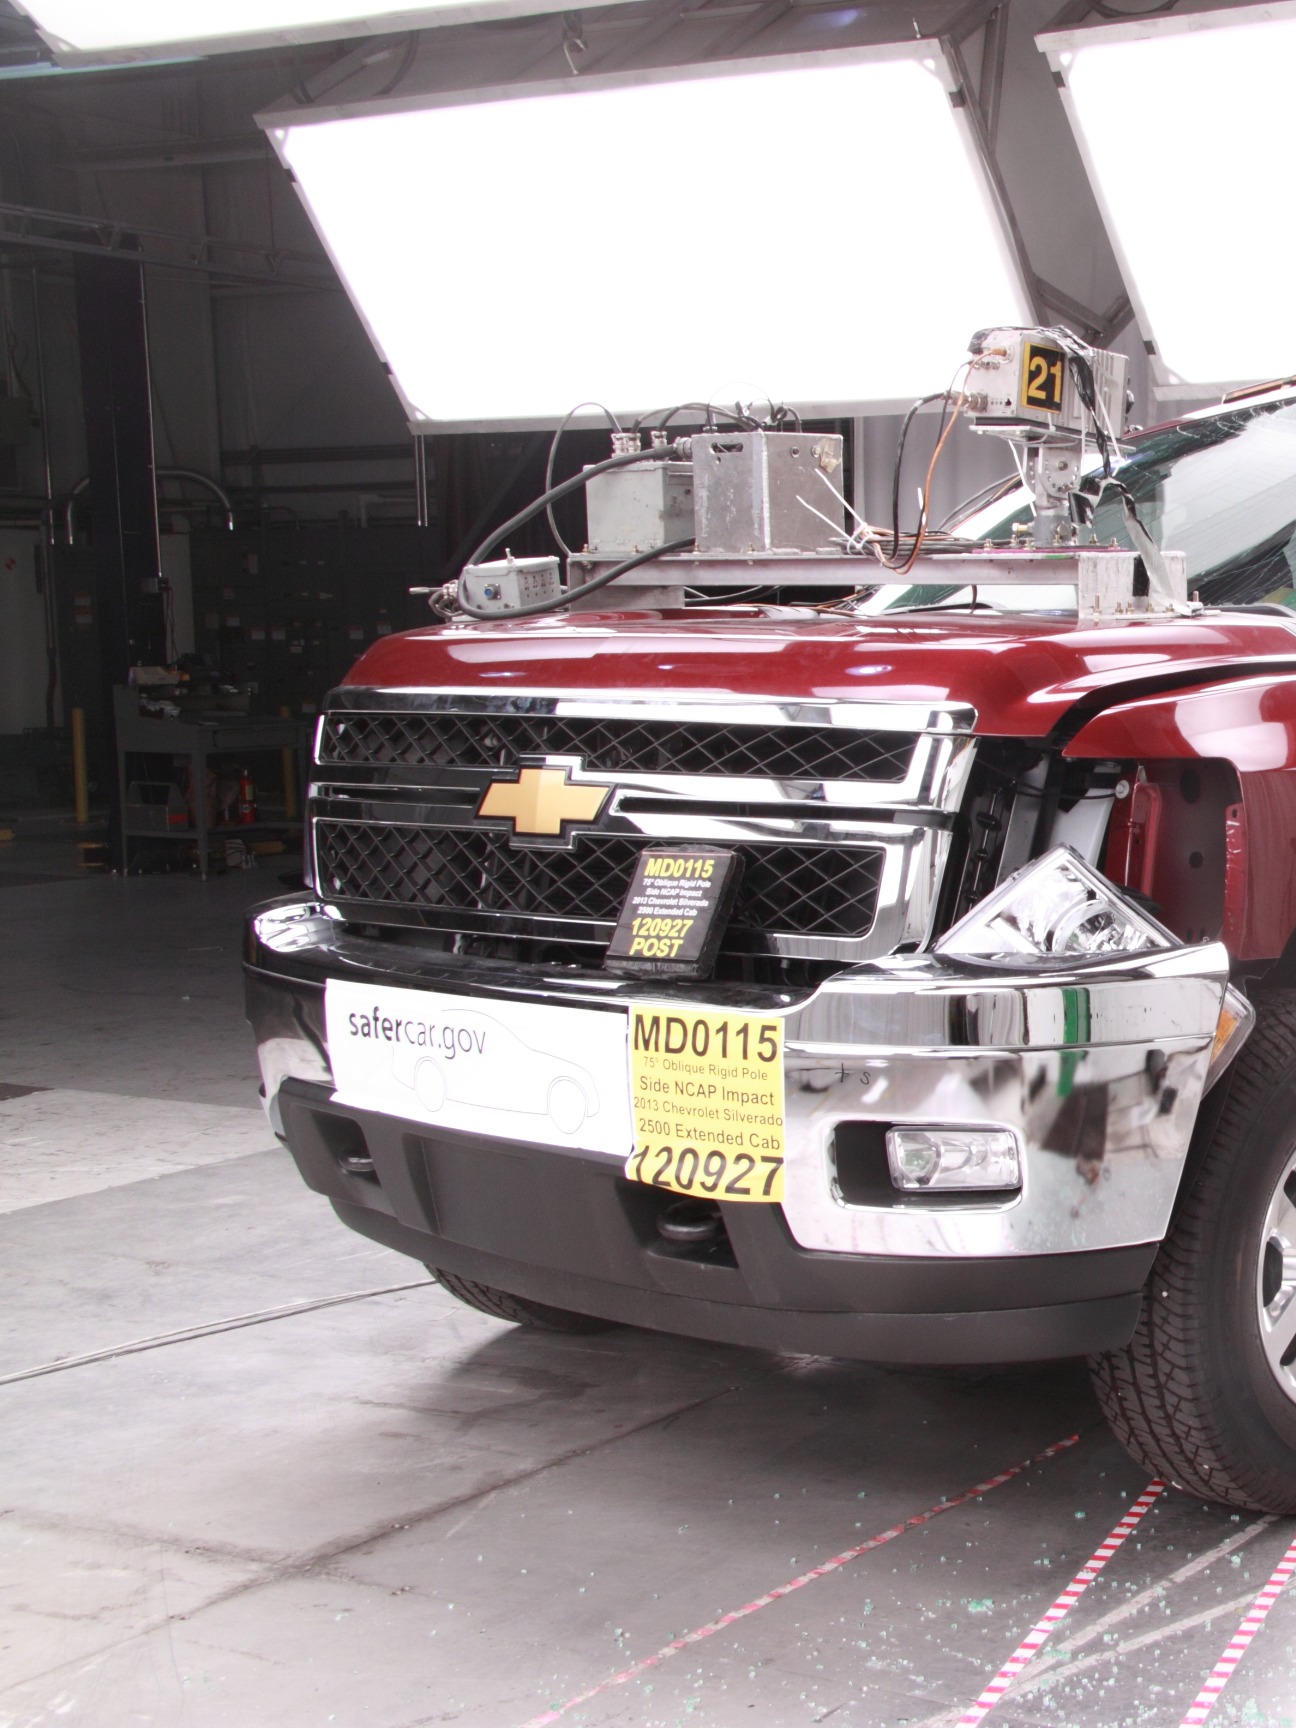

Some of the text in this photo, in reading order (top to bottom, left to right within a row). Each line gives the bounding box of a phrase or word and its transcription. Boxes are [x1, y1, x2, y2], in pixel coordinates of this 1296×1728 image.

[1027, 355, 1063, 403] 21
[644, 858, 715, 879] MD0115
[645, 888, 702, 898] Side NCAP Impact
[654, 879, 678, 888] Oblique
[679, 879, 697, 889] Rigid
[697, 880, 712, 888] Pole
[637, 906, 698, 916] 2500 Extended Cab
[648, 897, 678, 906] Chevrolet
[679, 898, 709, 907] Silverado
[631, 917, 694, 938] 120927
[629, 938, 683, 958] POST
[349, 1006, 486, 1060] safercar.gov
[633, 1013, 778, 1063] MD0115
[662, 1058, 705, 1075] Oblique
[708, 1064, 738, 1080] Rigid
[742, 1068, 768, 1081] Pole
[639, 1075, 775, 1107] Side NCAP Impact
[633, 1096, 783, 1126] 2013 Chevrolet Silverado
[639, 1117, 781, 1150] 2500 Extended Cab
[632, 1145, 784, 1196] 120927
